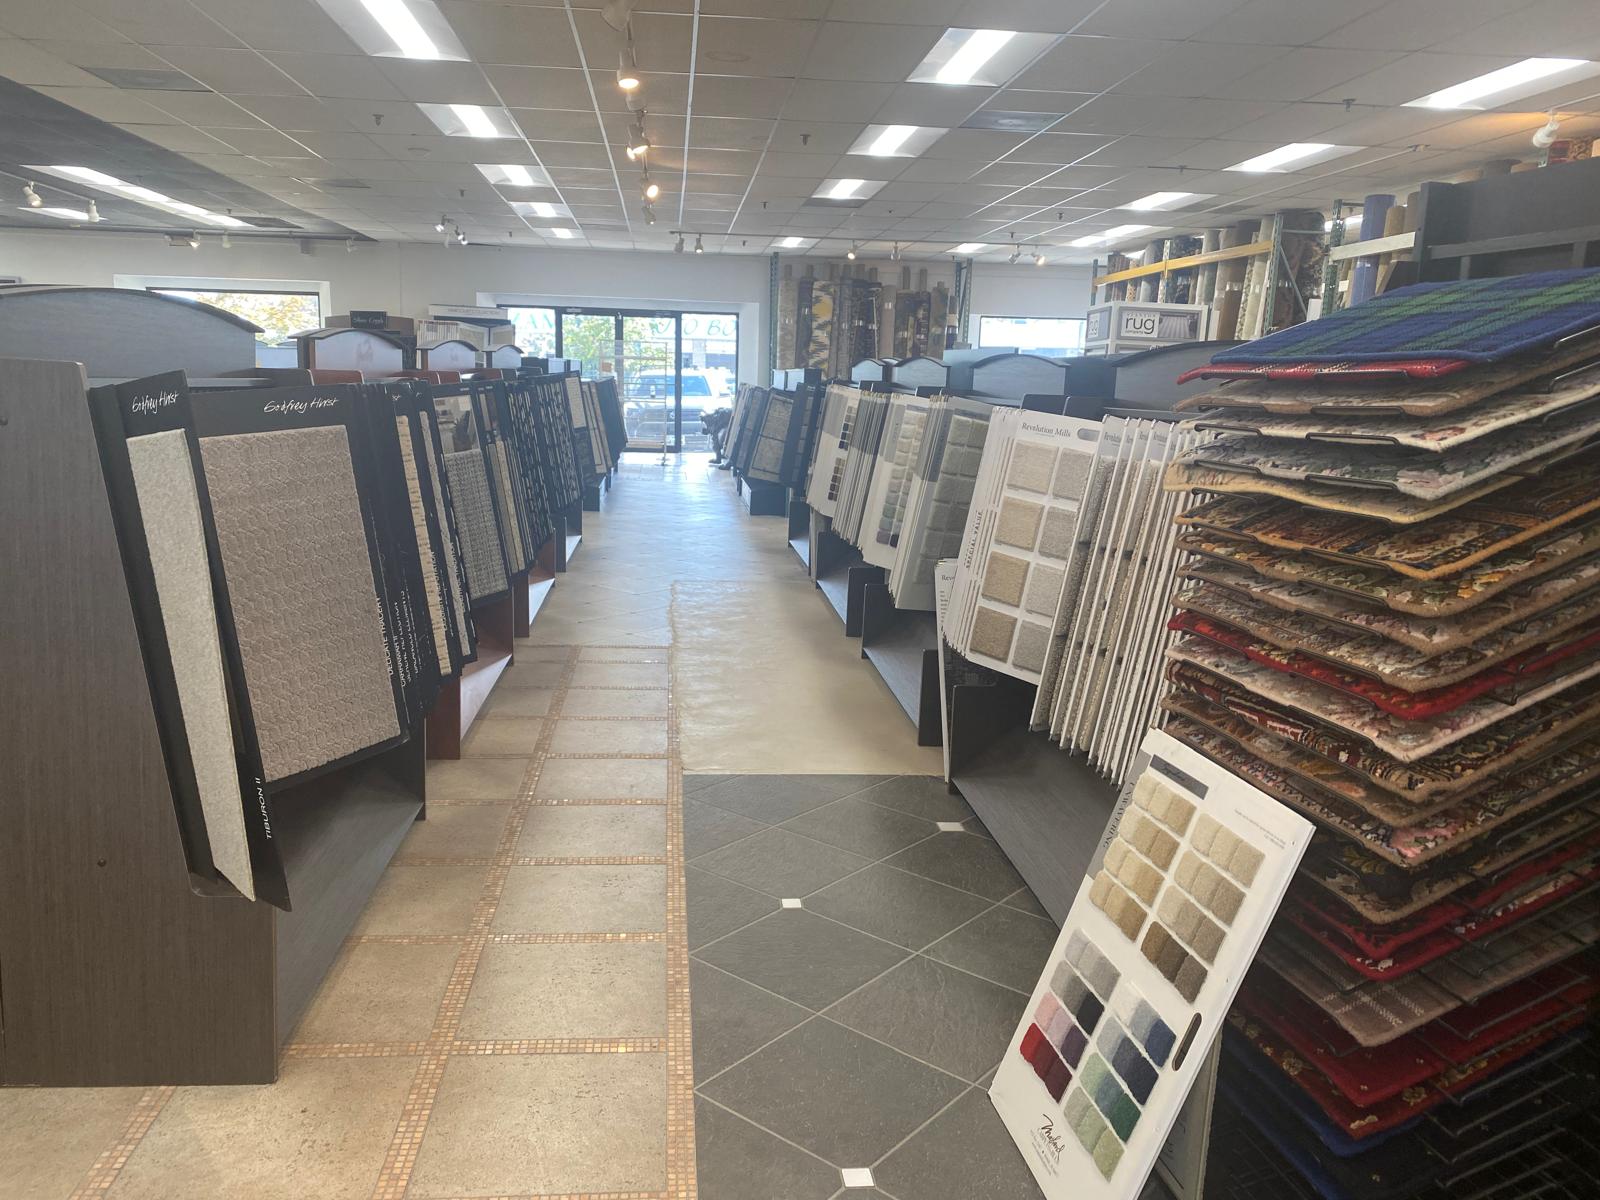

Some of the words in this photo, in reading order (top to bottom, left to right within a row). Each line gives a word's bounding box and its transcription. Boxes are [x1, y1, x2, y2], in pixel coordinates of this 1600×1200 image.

[1125, 317, 1155, 334] rug
[264, 400, 307, 414] Godfrey
[1055, 428, 1071, 438] Mills
[257, 787, 272, 839] TIBURON
